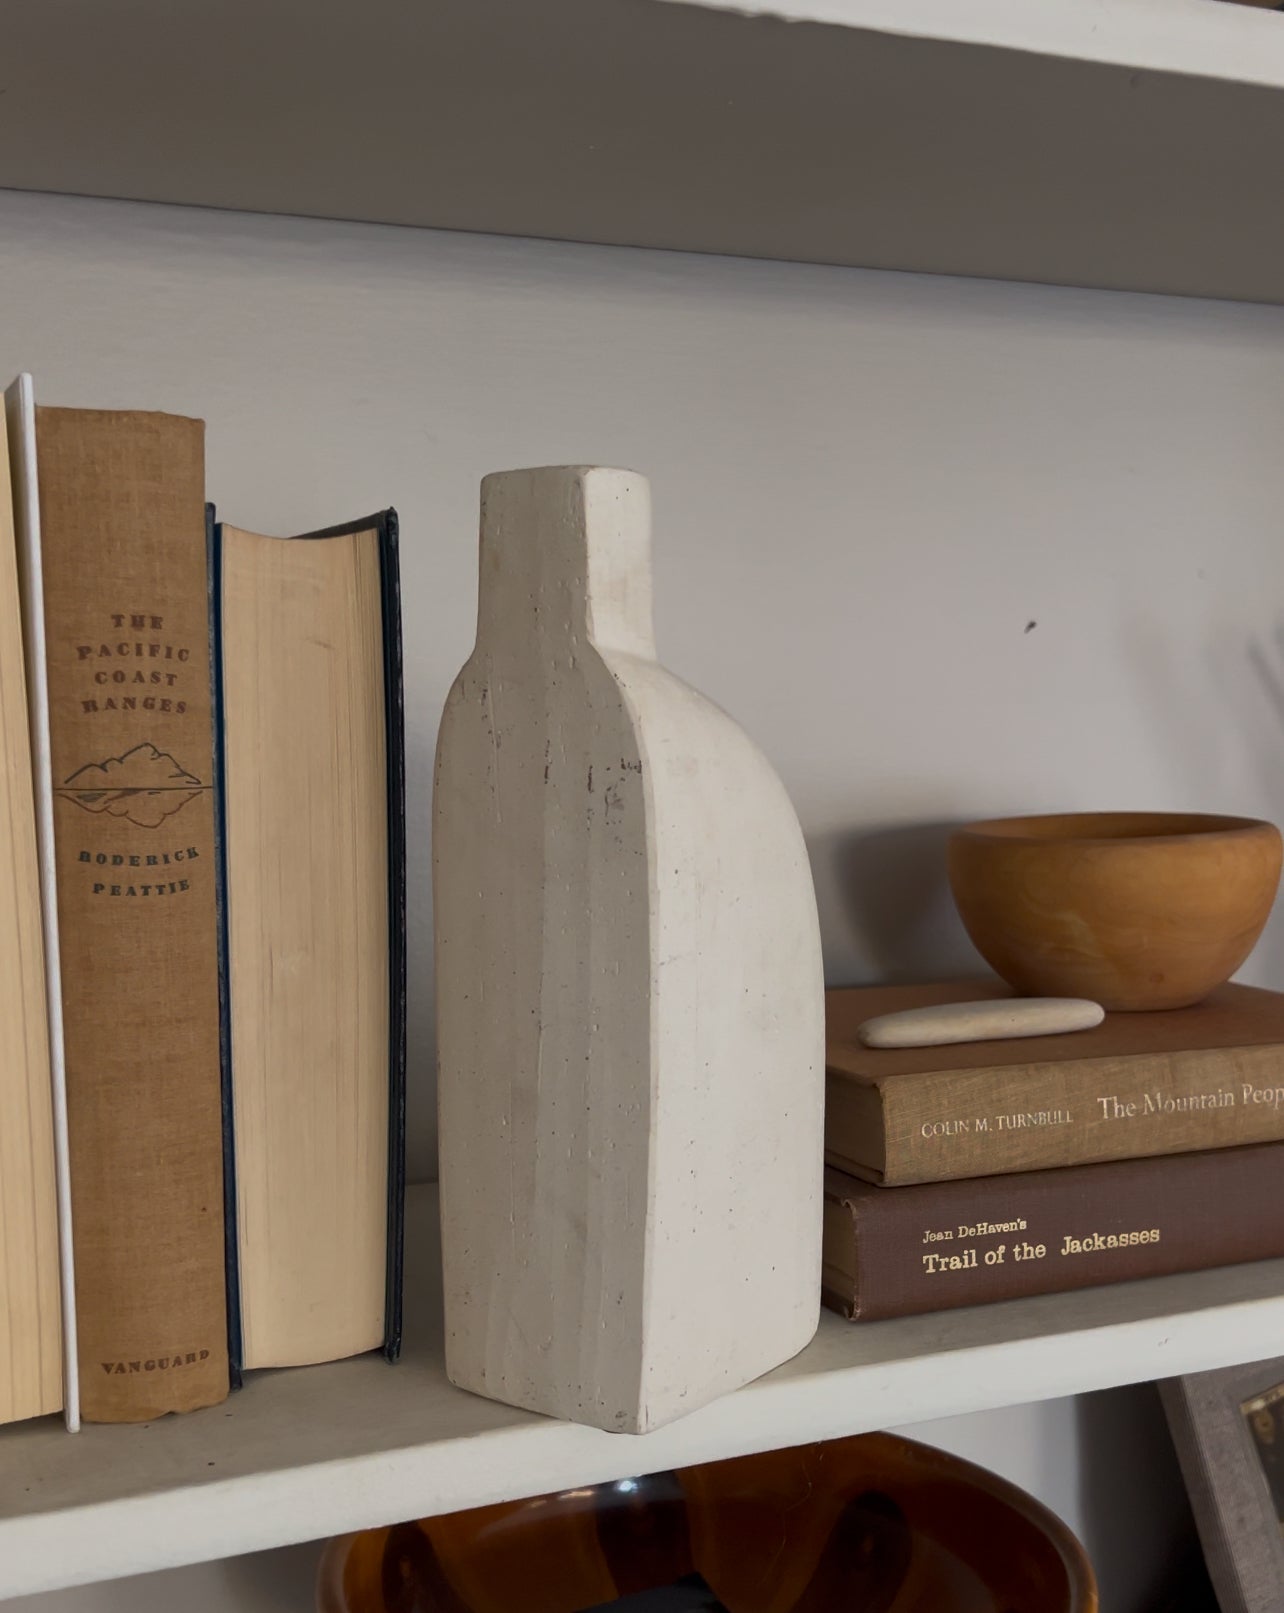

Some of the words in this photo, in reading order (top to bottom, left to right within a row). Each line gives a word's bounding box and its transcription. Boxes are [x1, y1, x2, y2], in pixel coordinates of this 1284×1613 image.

[111, 614, 164, 629] THE
[76, 642, 190, 662] PACIFIC
[94, 670, 178, 686] COAST
[81, 697, 187, 714] RANGES
[78, 847, 200, 867] RODERICK
[92, 879, 190, 897] PEATTIE
[921, 1118, 970, 1138] COLIN
[974, 1117, 993, 1132] M.
[995, 1109, 1074, 1129] TURNBULL
[1097, 1095, 1138, 1120] The
[1143, 1087, 1235, 1116] Mountain
[922, 1228, 953, 1244] Jean
[958, 1218, 1027, 1239] DeHaven's
[923, 1248, 978, 1274] Trail
[984, 1244, 1008, 1264] of
[1013, 1241, 1047, 1262] the
[1061, 1228, 1160, 1256] Jackasses
[101, 1349, 209, 1375] VANGUARD
